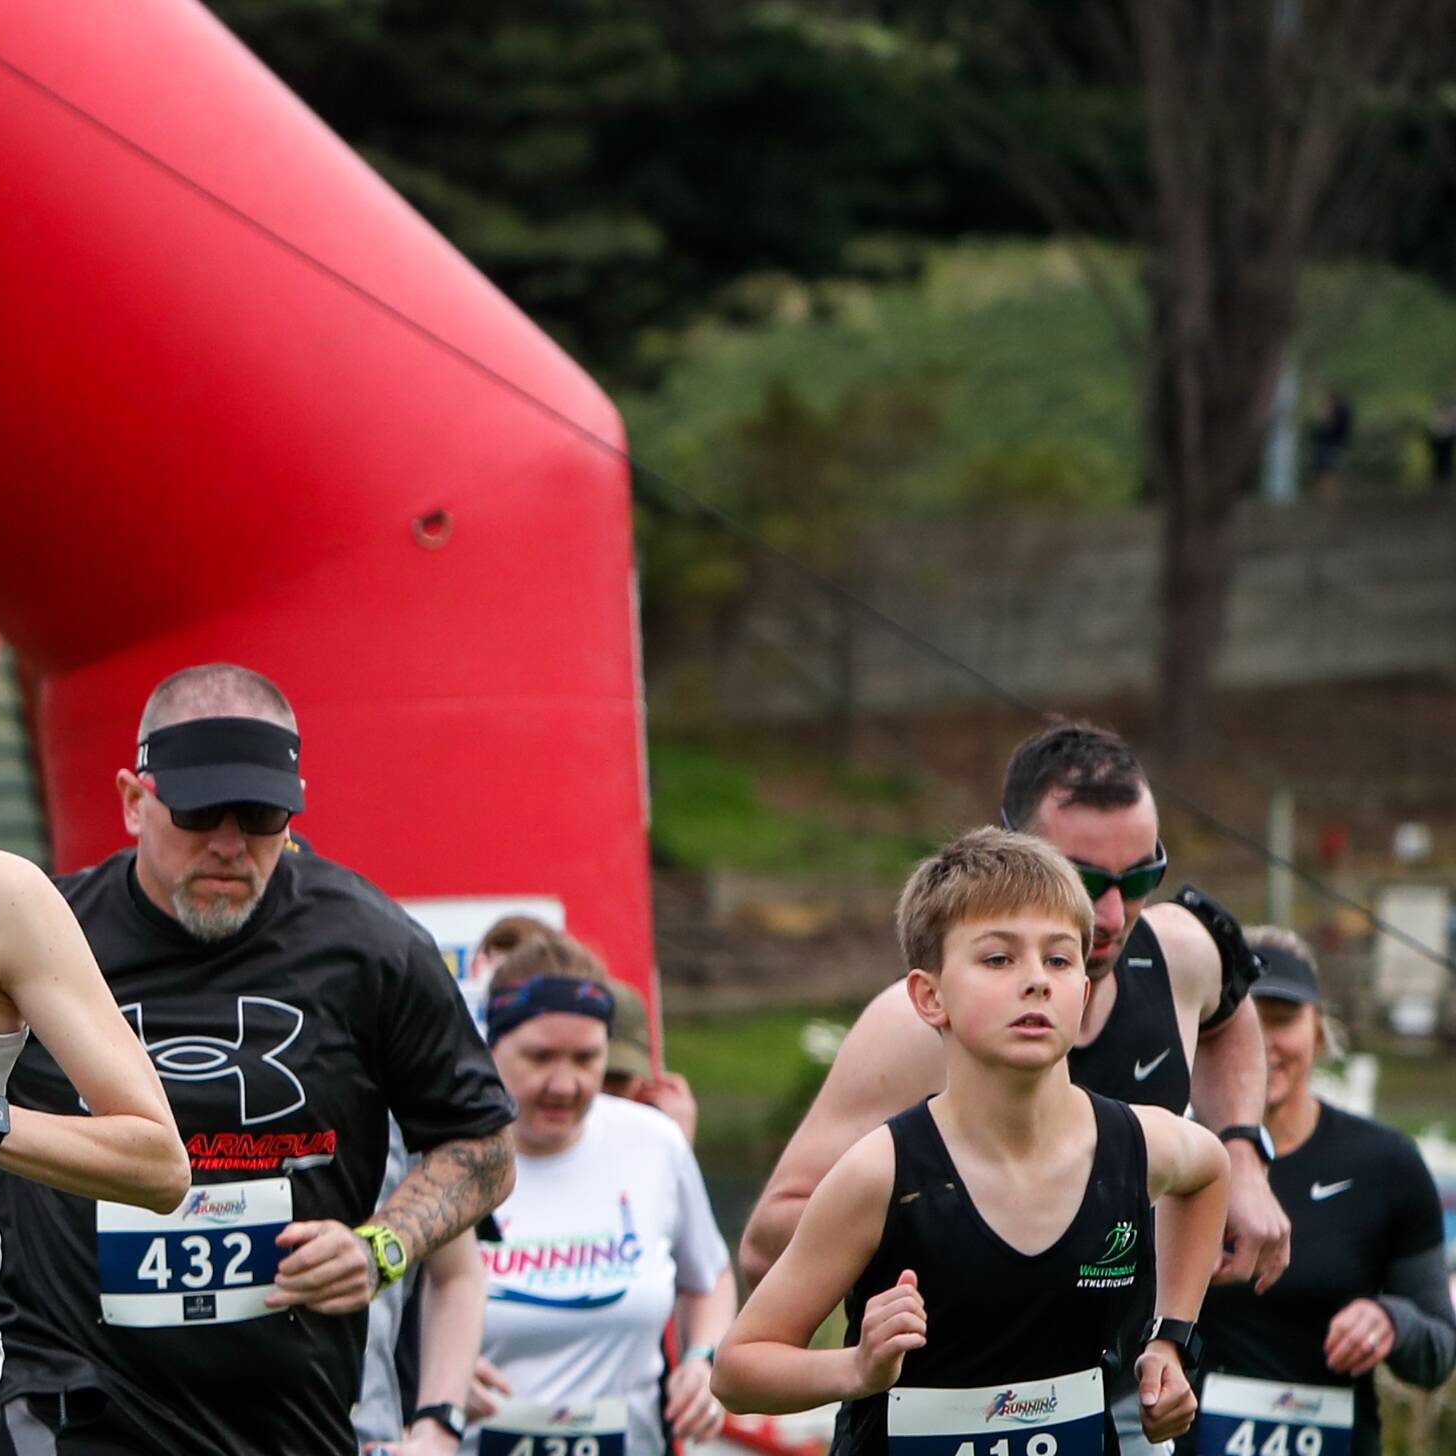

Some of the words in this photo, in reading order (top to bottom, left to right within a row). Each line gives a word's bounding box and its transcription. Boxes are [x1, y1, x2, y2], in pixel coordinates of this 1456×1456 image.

[186, 1129, 337, 1157] ARMOUR
[198, 1157, 280, 1169] PERFORMANCE
[138, 1232, 253, 1289] 432
